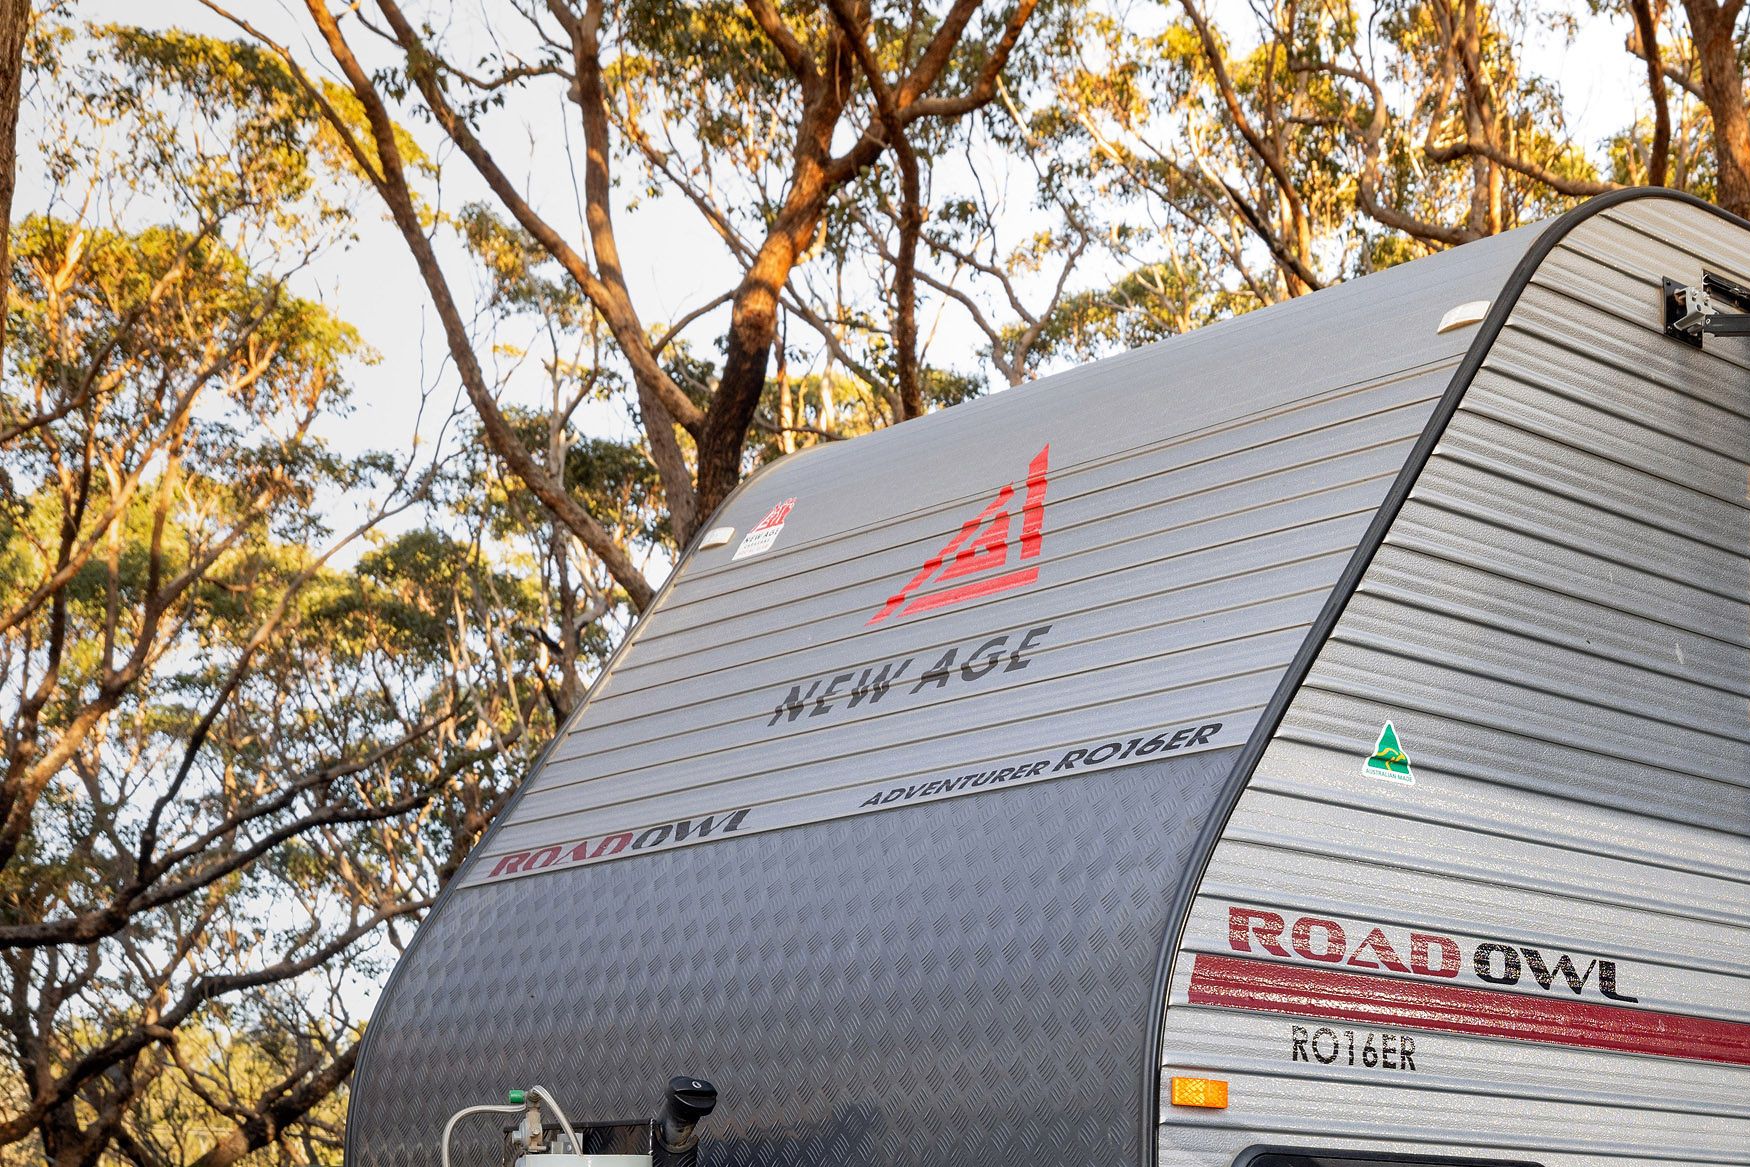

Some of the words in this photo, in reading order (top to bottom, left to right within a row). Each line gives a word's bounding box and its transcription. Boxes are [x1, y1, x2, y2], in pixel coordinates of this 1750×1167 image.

[767, 657, 915, 727] NEW
[909, 624, 1053, 695] AGE
[859, 760, 1051, 808] ADVENTURER
[1052, 722, 1223, 772] RO16ER
[1366, 768, 1396, 778] AUSTRALIAN
[1291, 1025, 1417, 1072] RO16ER
